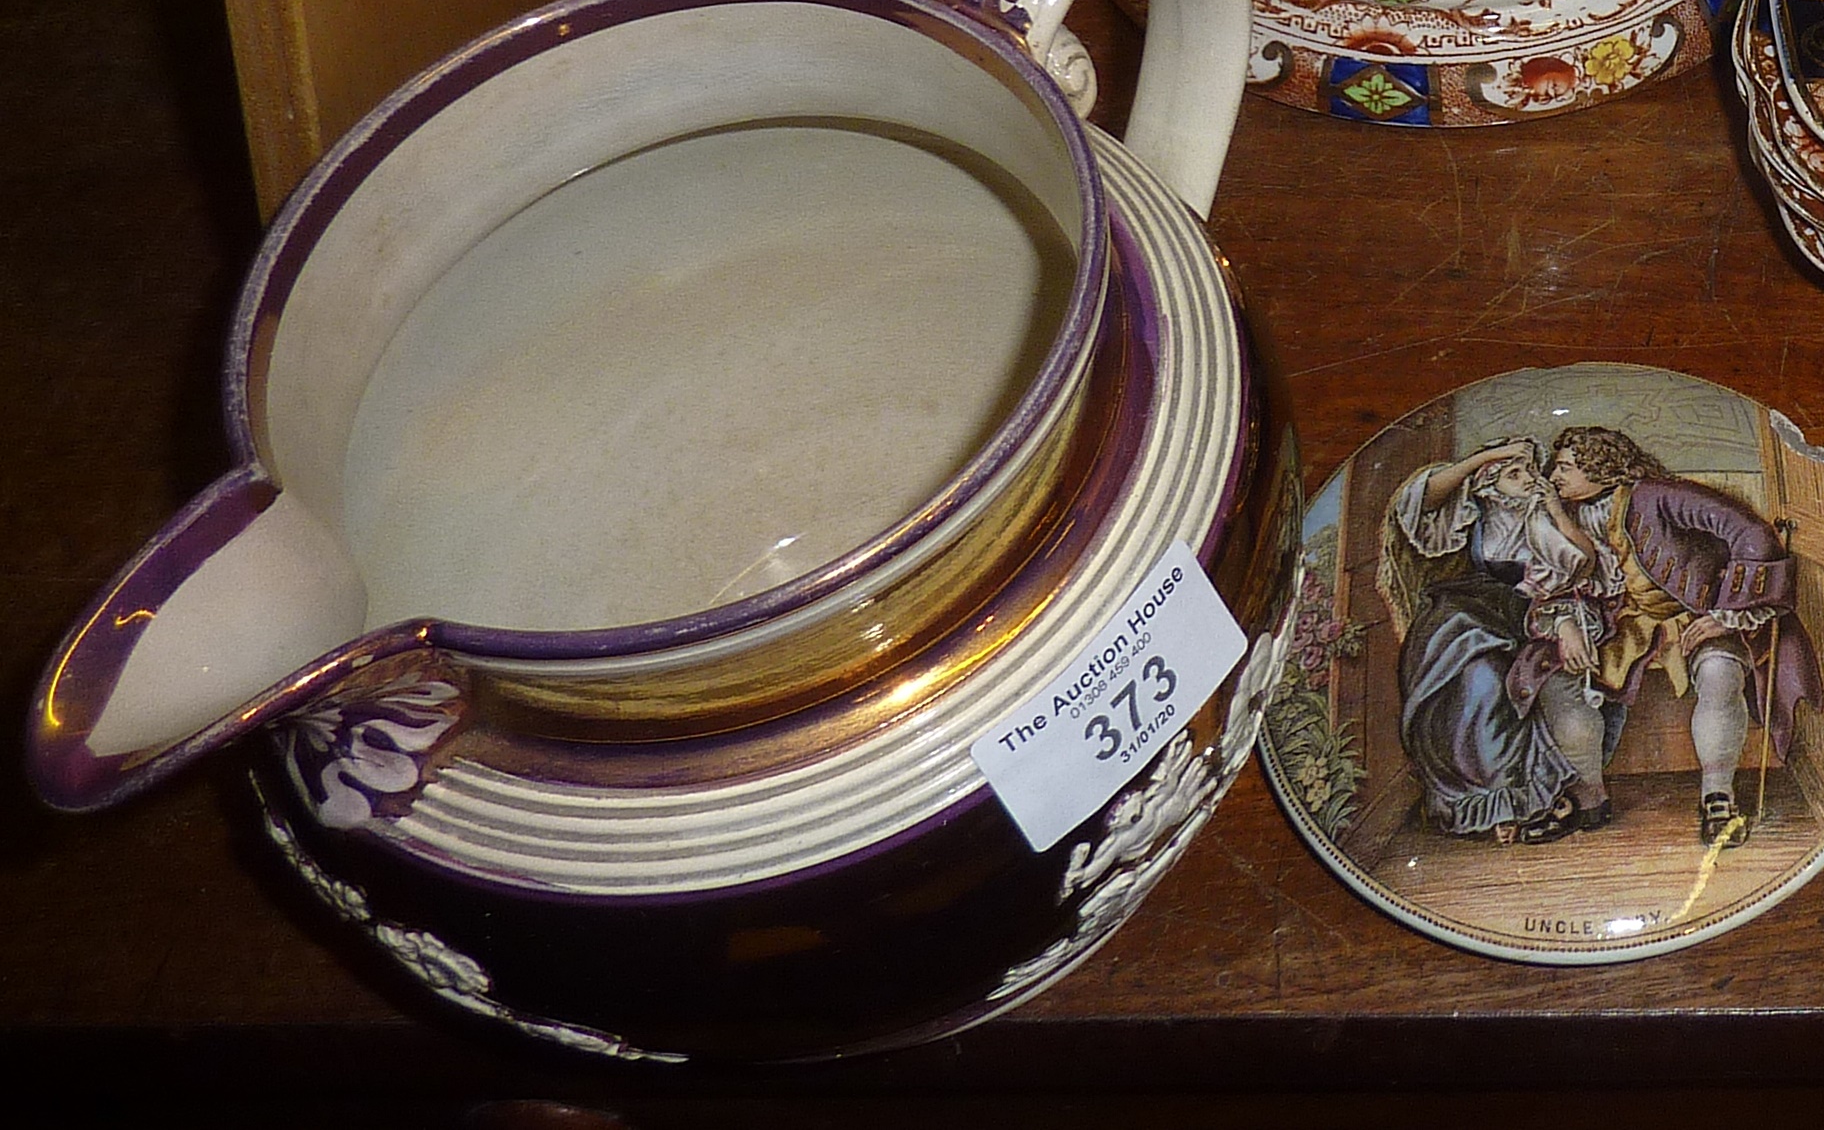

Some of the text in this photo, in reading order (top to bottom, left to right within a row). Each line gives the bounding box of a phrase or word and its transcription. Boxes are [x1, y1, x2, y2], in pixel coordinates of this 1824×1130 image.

[998, 565, 1183, 753] The Auction House
[1070, 631, 1151, 719] 01308 459 400
[1084, 655, 1178, 761] 373
[1119, 703, 1176, 764] 31/01/20
[1524, 917, 1594, 935] UNCLE
